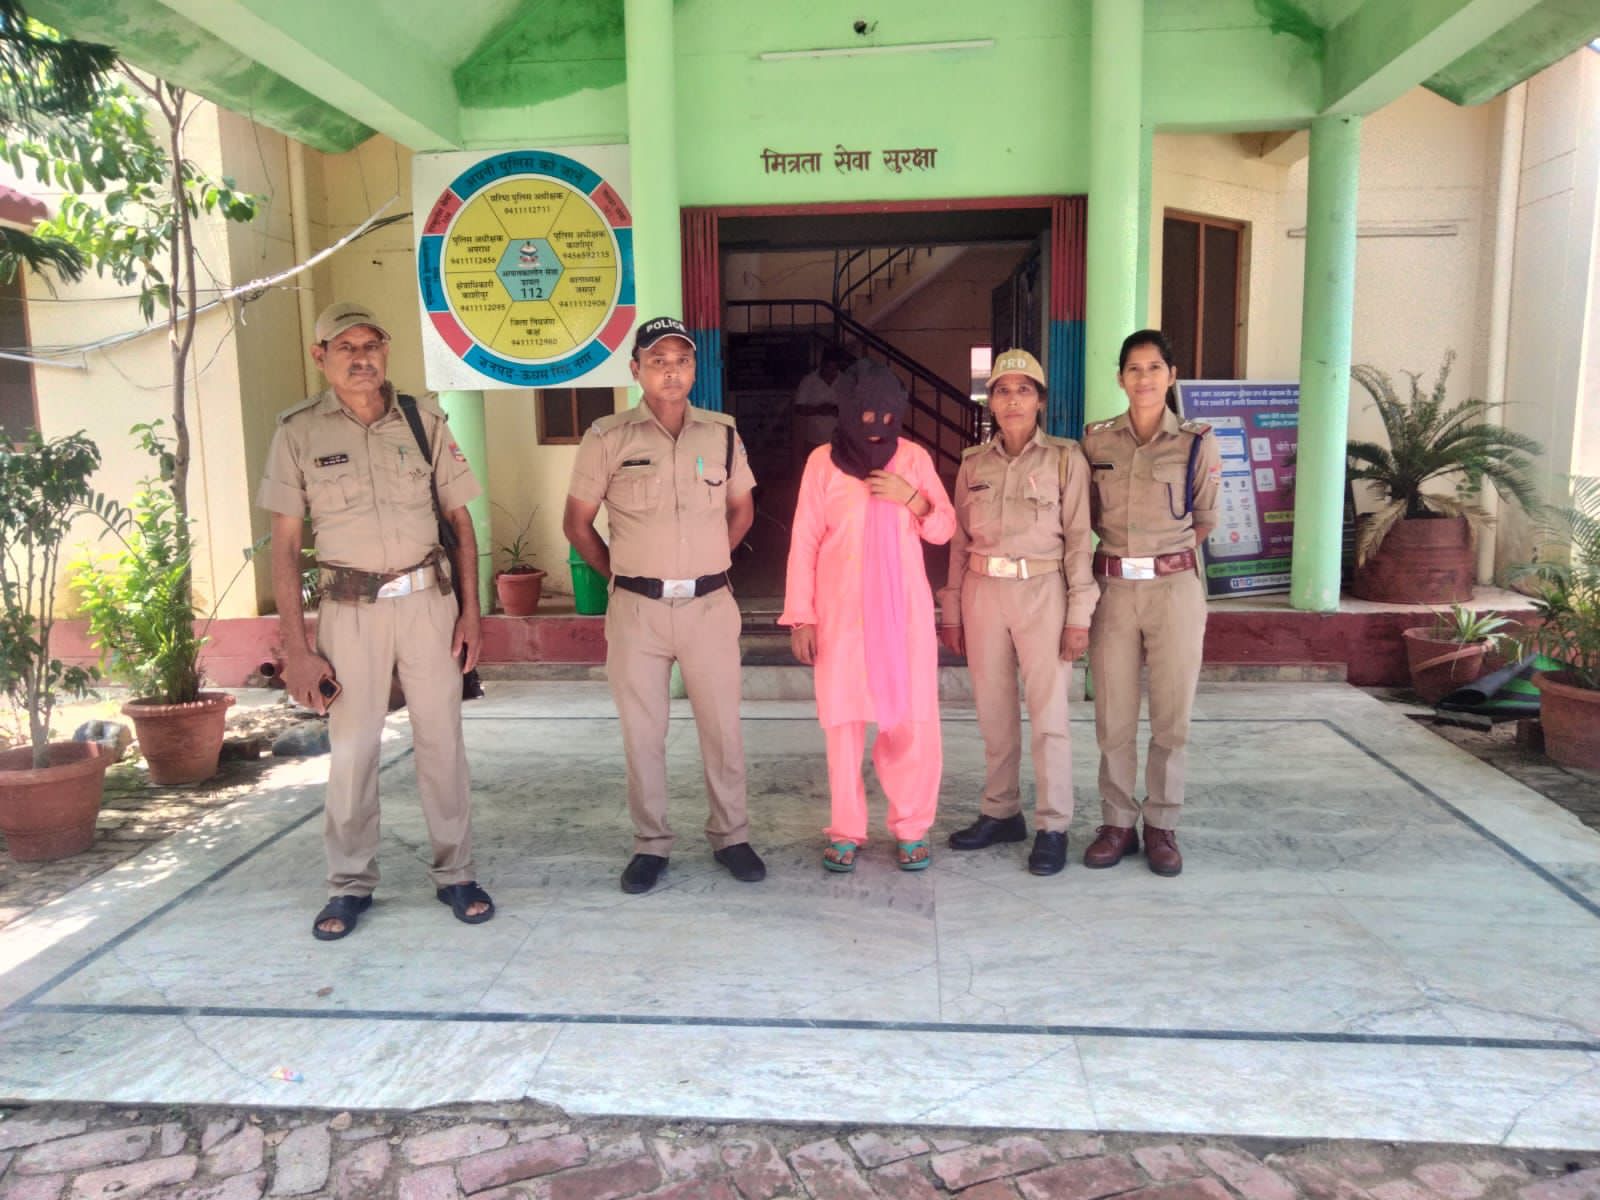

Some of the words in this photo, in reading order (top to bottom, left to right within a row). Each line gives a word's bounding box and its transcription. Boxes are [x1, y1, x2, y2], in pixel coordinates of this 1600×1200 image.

[501, 156, 534, 175] पुलिस
[540, 157, 556, 170] को
[760, 148, 822, 174] मित्रता
[834, 144, 872, 175] सेवा
[882, 147, 938, 174] सुरक्षा
[512, 191, 532, 204] पुलिस
[452, 234, 472, 248] पुलिस
[553, 230, 574, 243] पुलिस
[521, 287, 544, 299] 112
